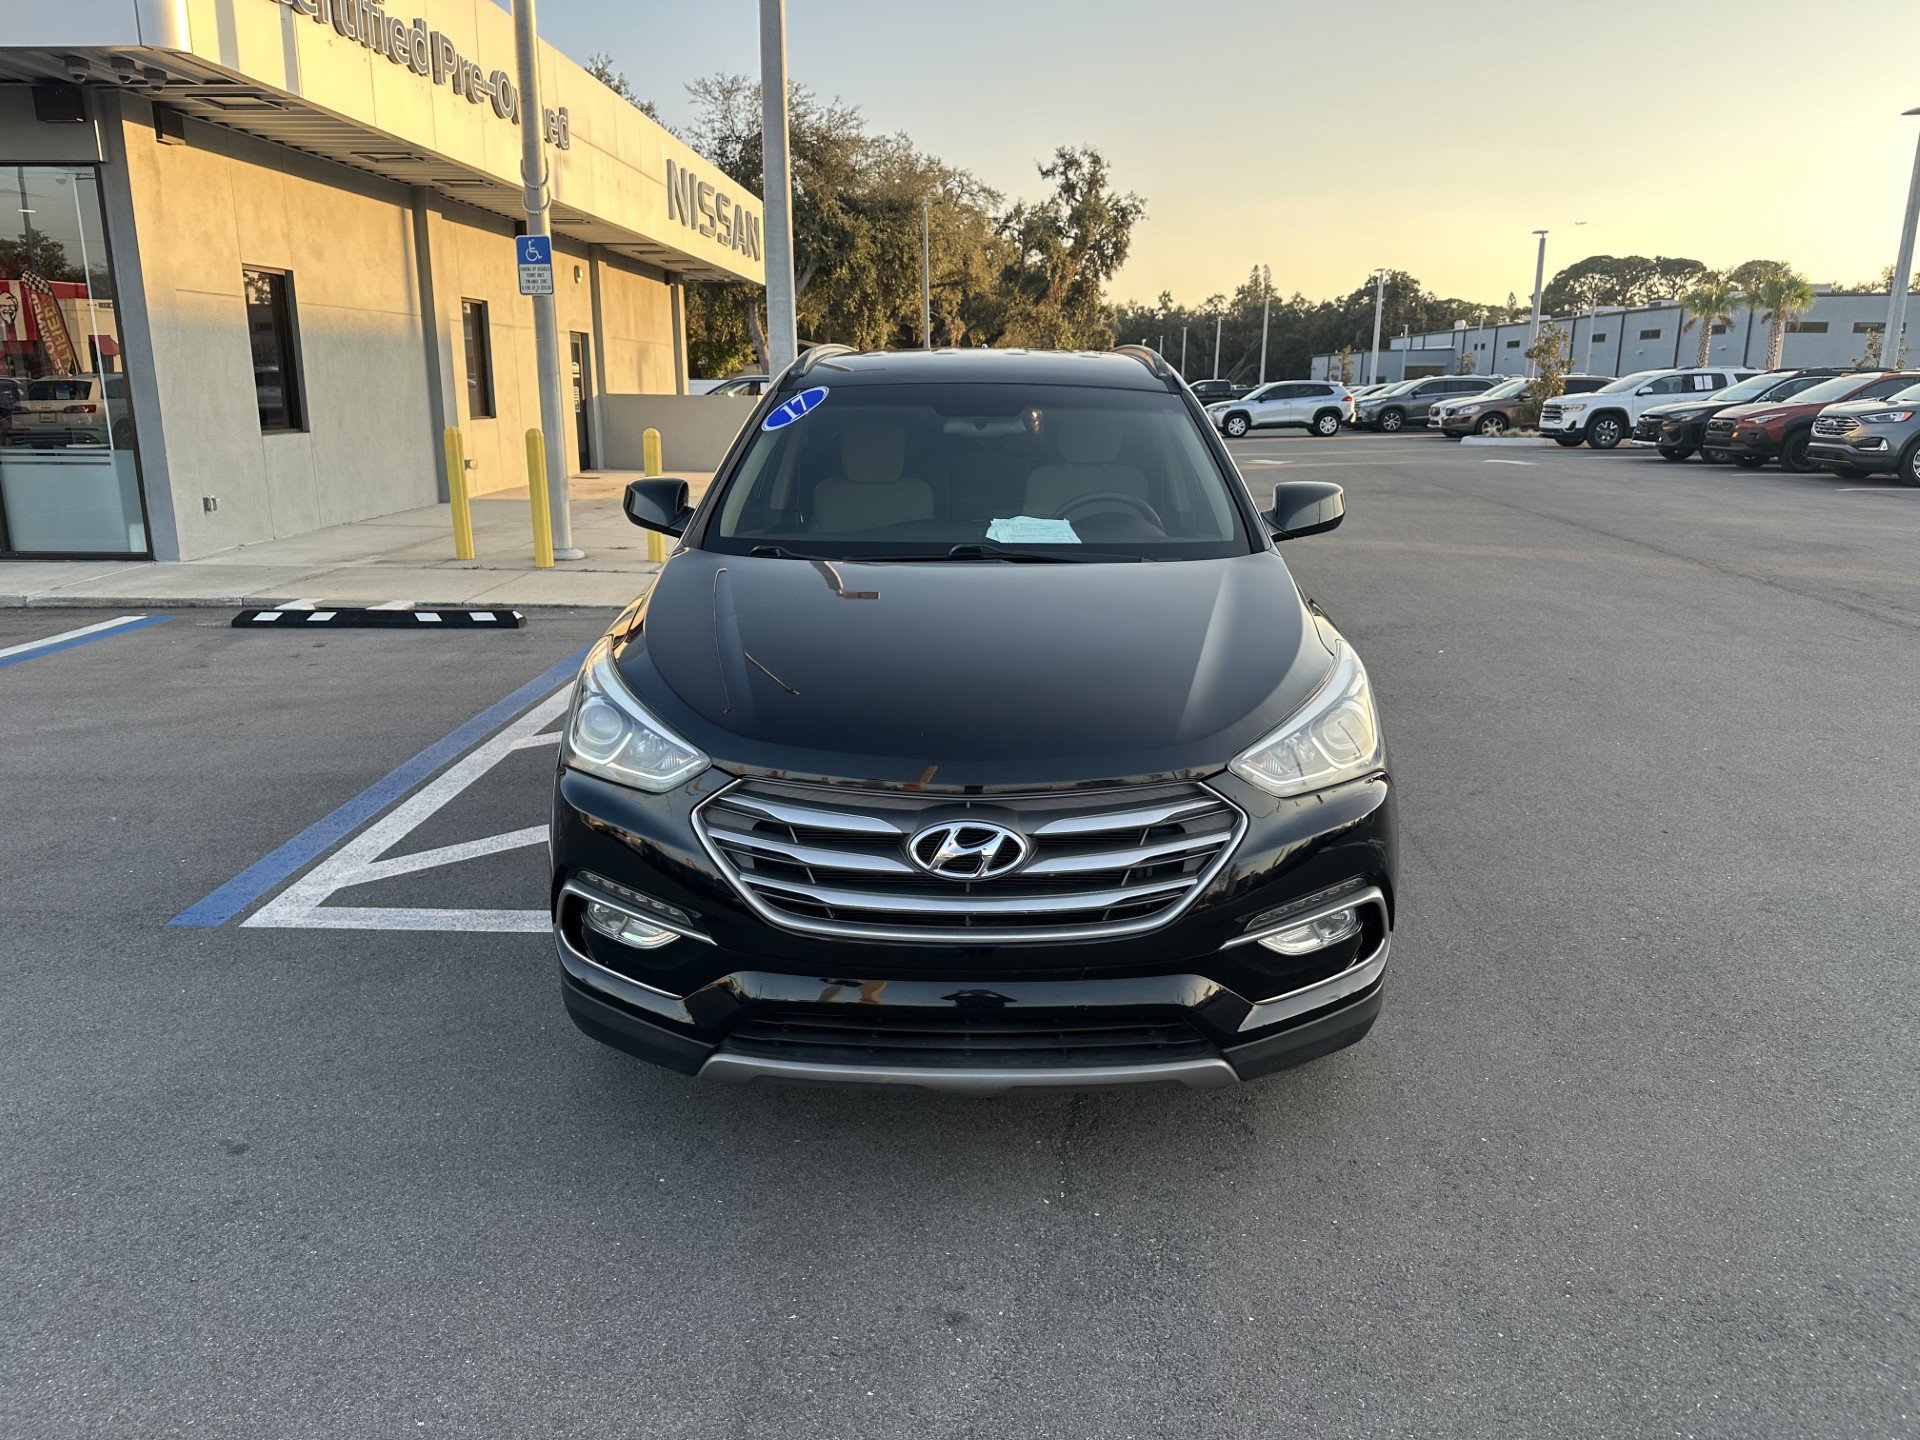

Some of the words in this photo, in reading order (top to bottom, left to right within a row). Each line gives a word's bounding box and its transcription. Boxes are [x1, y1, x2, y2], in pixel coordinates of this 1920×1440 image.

[269, 0, 430, 76] tified
[431, 31, 570, 150] Pre-Oed
[666, 158, 761, 262] NISSAN
[779, 394, 808, 422] 17
